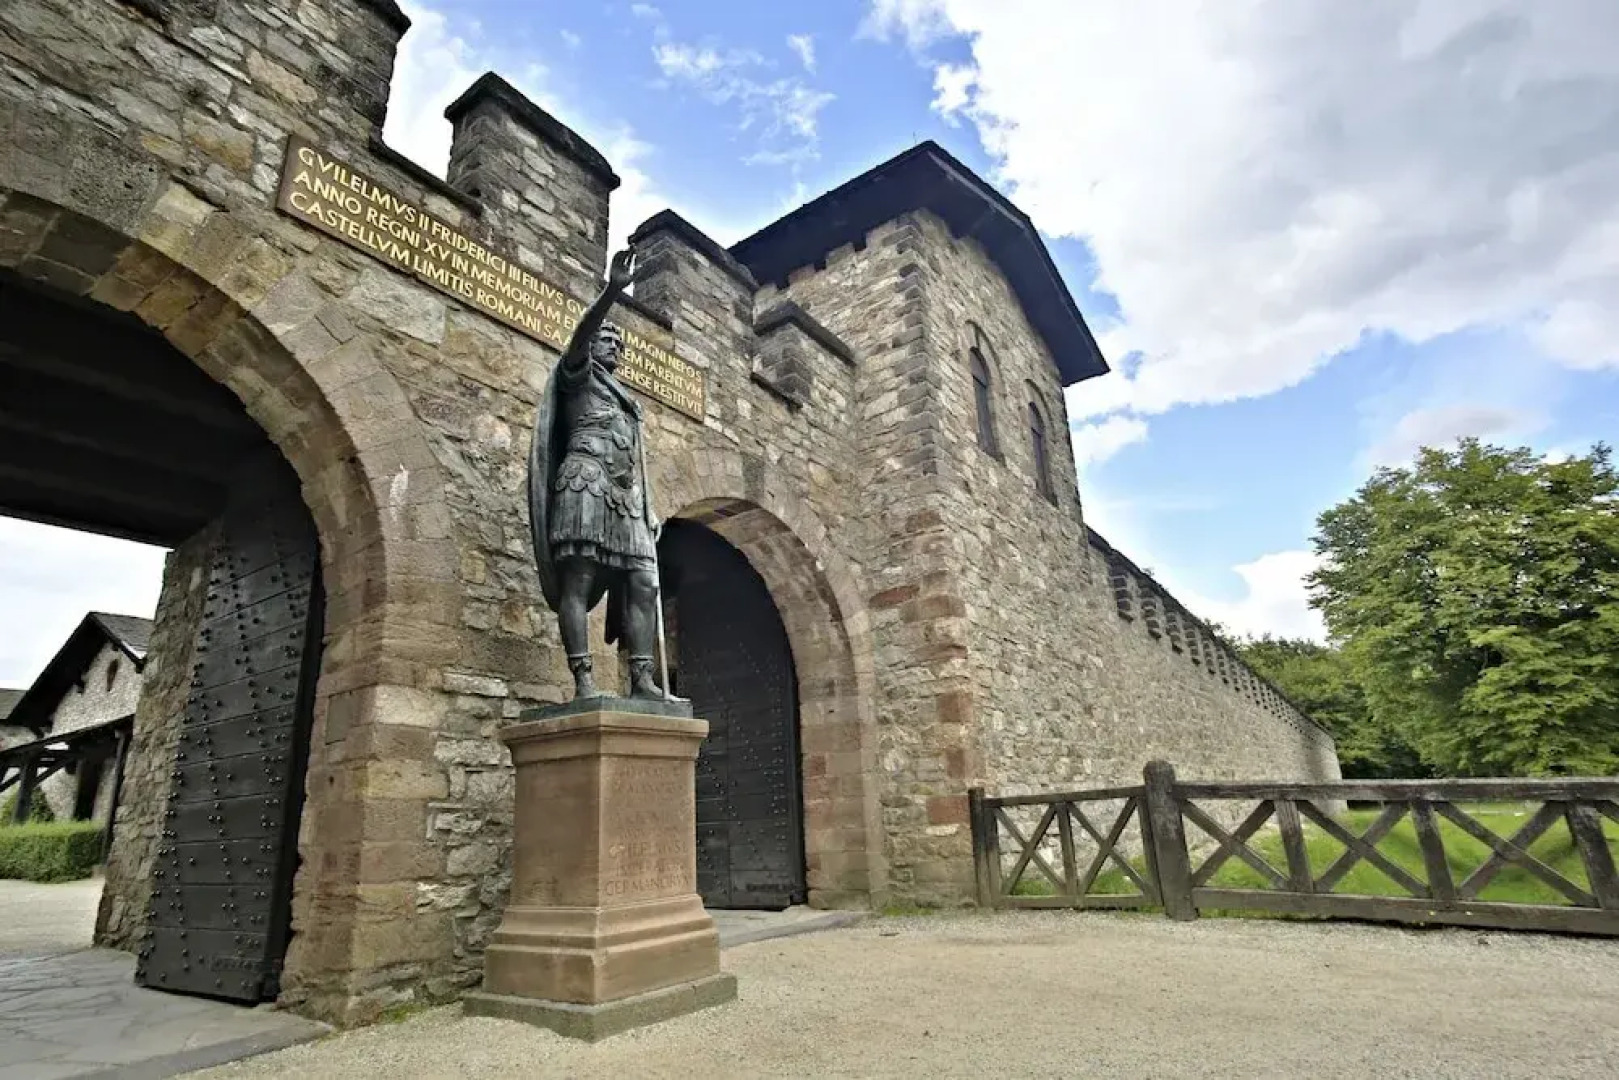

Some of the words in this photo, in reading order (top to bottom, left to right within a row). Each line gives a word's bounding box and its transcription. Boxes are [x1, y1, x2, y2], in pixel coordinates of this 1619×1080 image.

[290, 192, 410, 265] CASTELLVM
[413, 255, 474, 297] LIMITIS
[476, 287, 541, 333] ROMANI
[294, 170, 362, 214] ANNO
[366, 207, 420, 247] REGNI
[424, 238, 450, 261] XV
[451, 252, 469, 274] IN
[470, 264, 561, 324] MEMORIAM
[299, 147, 416, 223] GVILELMVS
[419, 213, 430, 231] II
[432, 221, 506, 275] FRIDERICI
[509, 264, 521, 283] III
[523, 273, 564, 306] FILIVS
